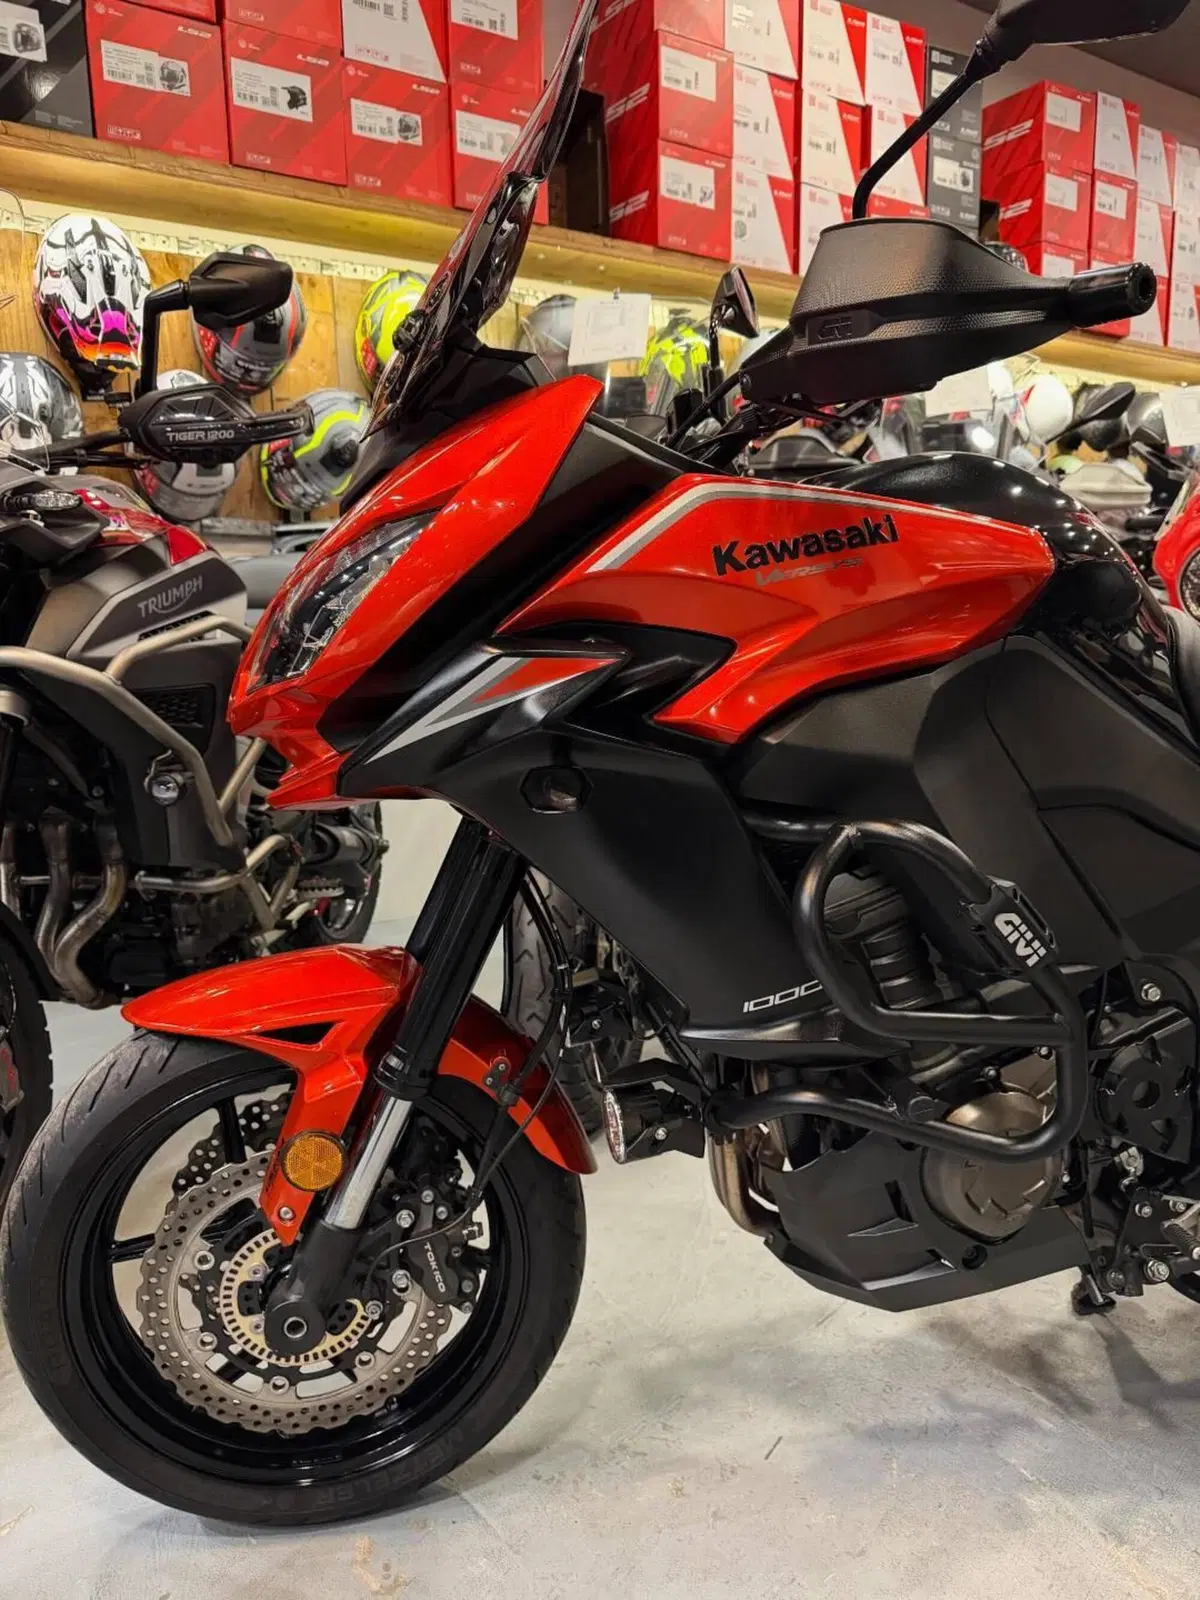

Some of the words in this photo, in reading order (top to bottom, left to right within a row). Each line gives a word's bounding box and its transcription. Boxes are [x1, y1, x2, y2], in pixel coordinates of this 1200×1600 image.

[166, 430, 205, 443] TIGER
[207, 429, 235, 441] 1200
[712, 514, 900, 577] Kawasaki
[137, 575, 203, 618] TRIUMPH
[994, 912, 1047, 968] GIVI
[423, 1241, 447, 1294] TOKICO
